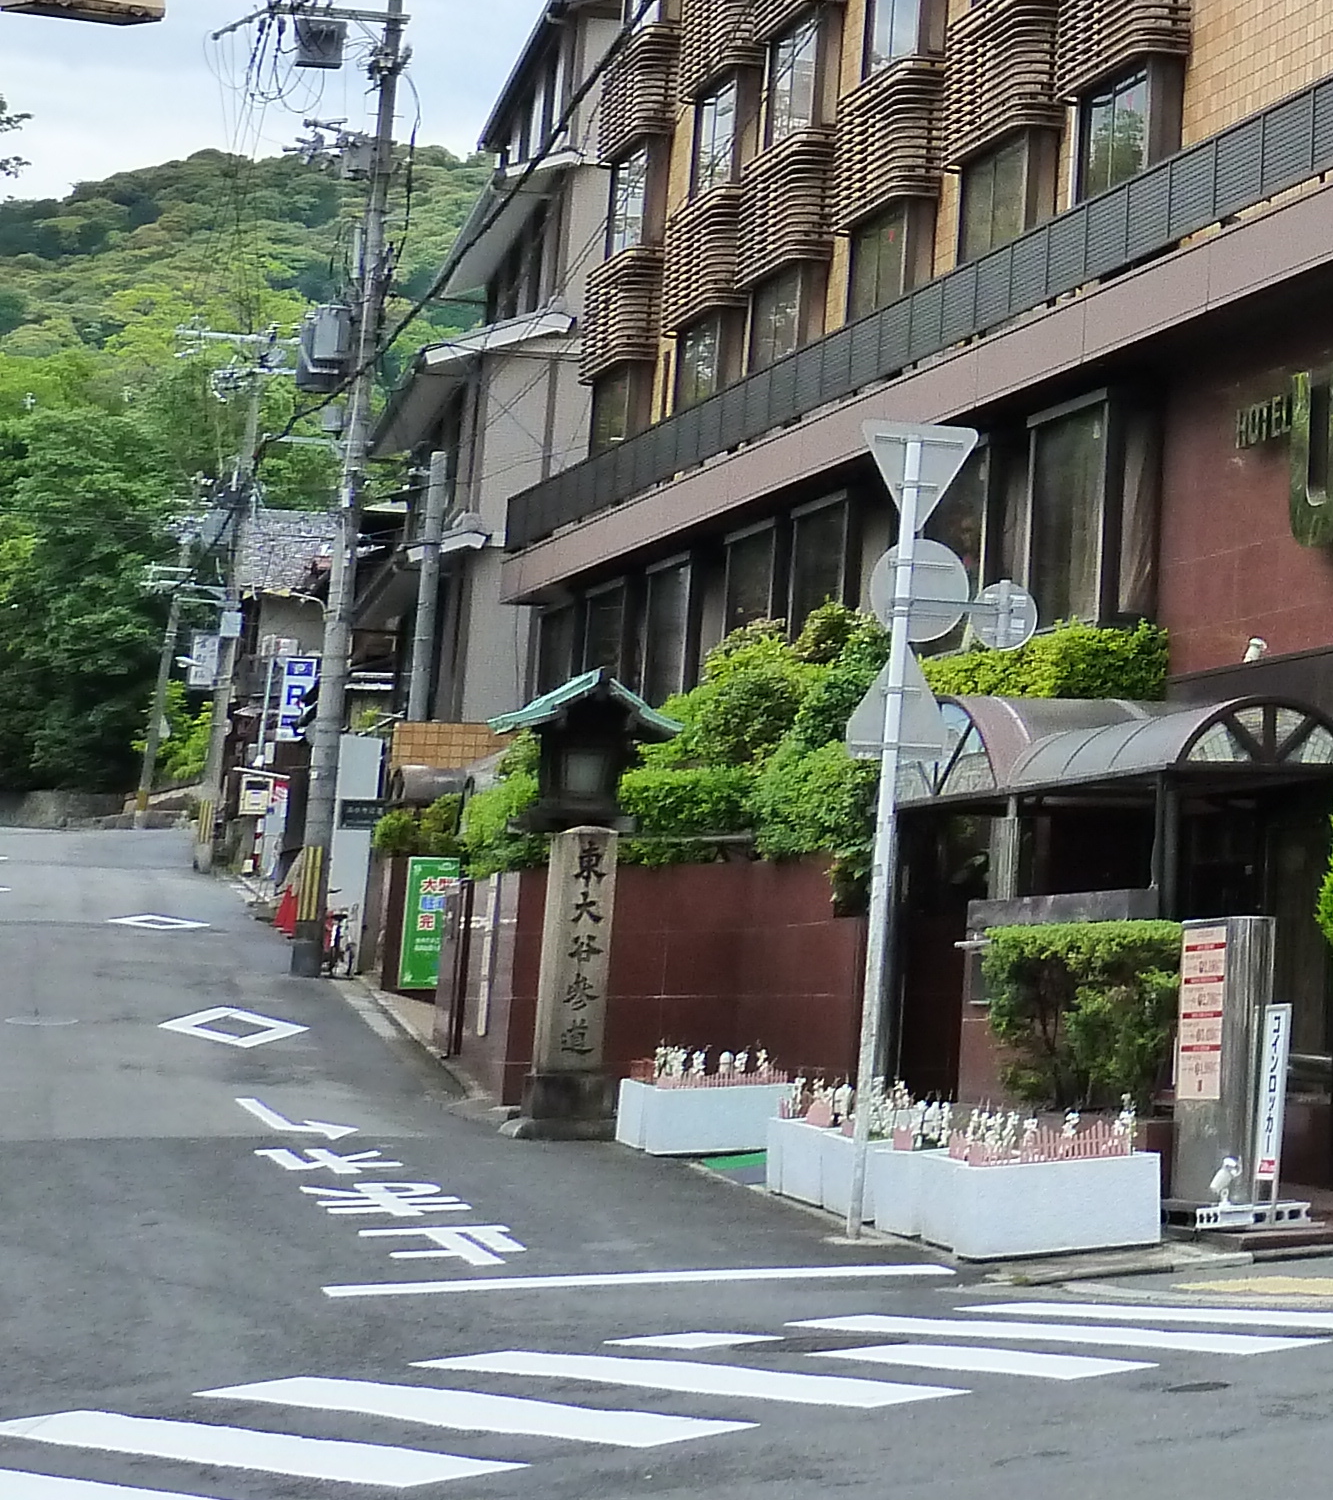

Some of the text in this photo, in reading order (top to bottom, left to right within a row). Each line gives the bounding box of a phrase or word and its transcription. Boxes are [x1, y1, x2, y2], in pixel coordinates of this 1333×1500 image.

[1235, 397, 1292, 449] HOTEL
[1264, 1015, 1281, 1153] コインロッカー
